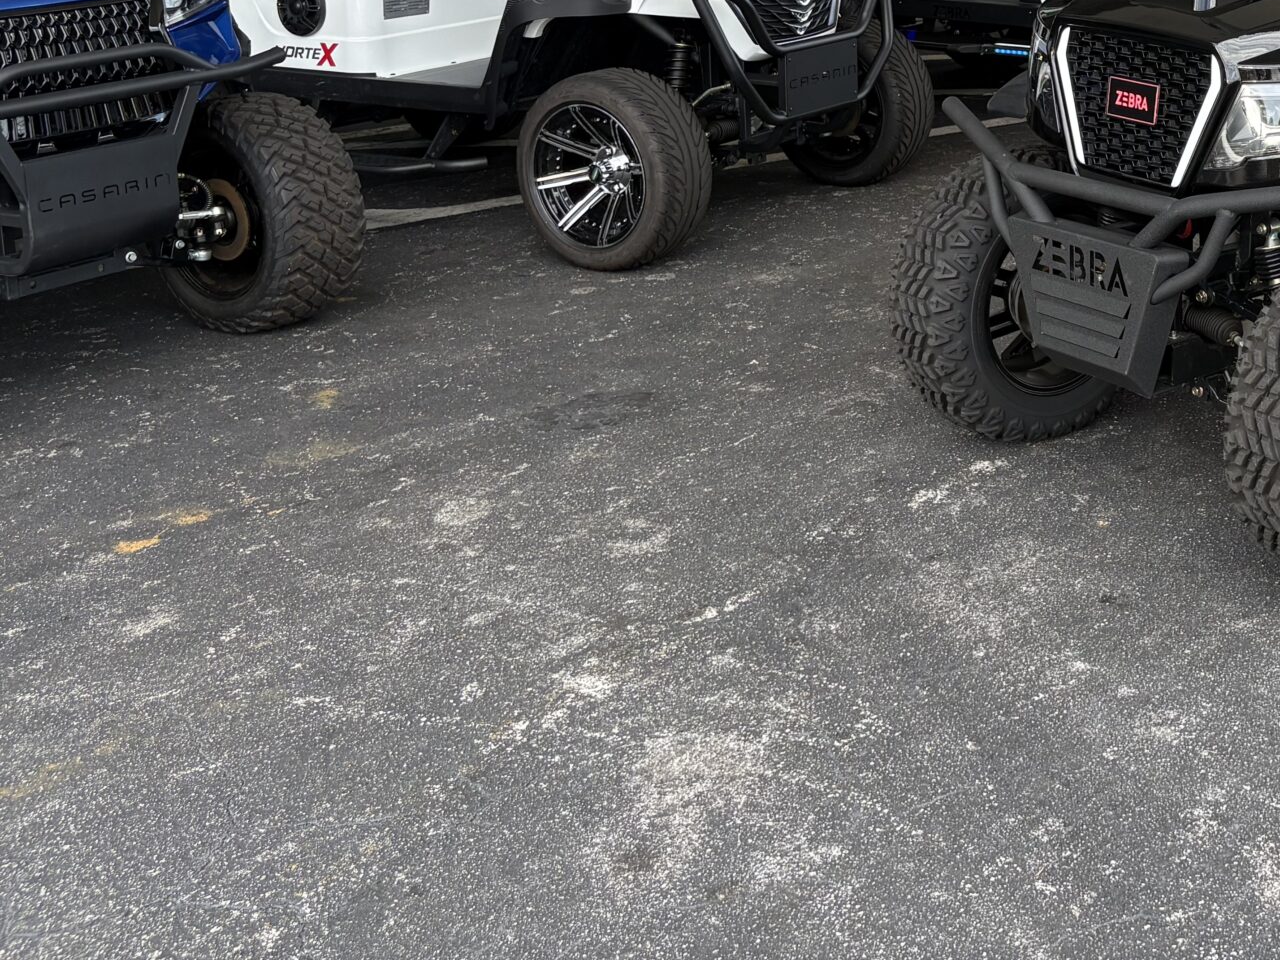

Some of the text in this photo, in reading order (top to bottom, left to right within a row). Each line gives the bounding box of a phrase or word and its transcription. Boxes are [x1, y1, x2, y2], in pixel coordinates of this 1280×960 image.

[279, 42, 338, 67] ORTEX
[1115, 90, 1148, 111] ZEBRA
[38, 172, 171, 212] CASARIN
[1032, 234, 1128, 297] ZEBRA
